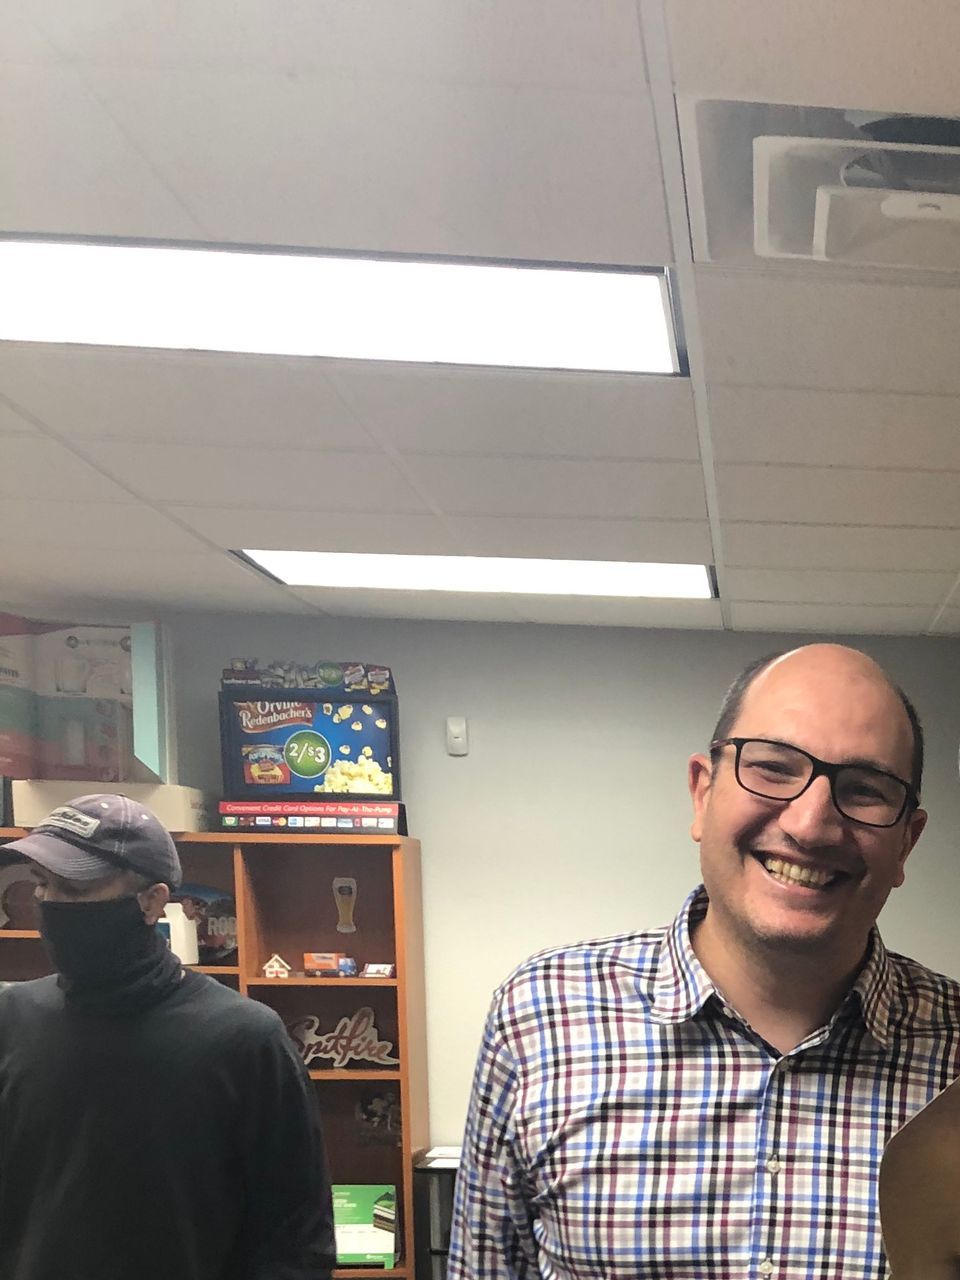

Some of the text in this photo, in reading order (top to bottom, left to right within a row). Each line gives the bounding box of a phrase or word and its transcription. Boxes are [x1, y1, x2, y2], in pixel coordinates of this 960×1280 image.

[239, 708, 313, 728] Redenbacher's
[289, 742, 326, 763] 2/$3
[262, 804, 282, 812] Credit
[300, 805, 325, 813] Options
[325, 805, 337, 813] For
[289, 1007, 394, 1066] Spitfire
